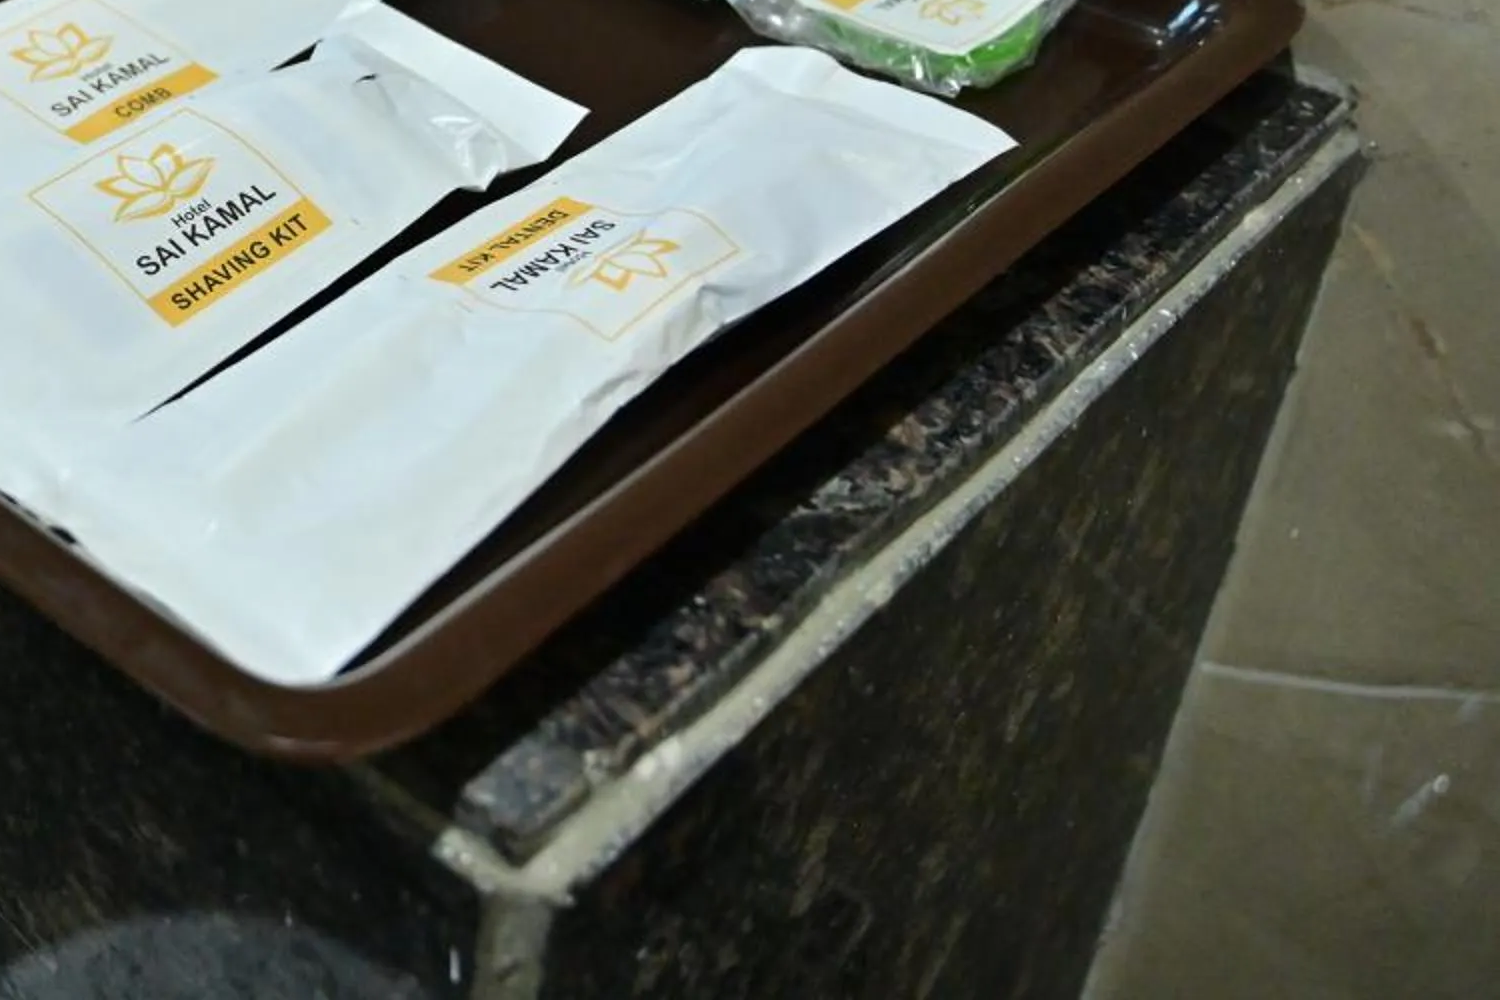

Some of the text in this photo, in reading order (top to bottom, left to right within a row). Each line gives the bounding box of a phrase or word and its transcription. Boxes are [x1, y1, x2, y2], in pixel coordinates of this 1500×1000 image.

[51, 89, 95, 117] SAI
[90, 53, 170, 93] KAMAL
[115, 87, 172, 118] COMB
[136, 185, 277, 276] SAI KAMAL
[171, 198, 211, 229] Hotel
[459, 209, 570, 272] DENTAL KIT
[569, 219, 616, 245] SAI
[171, 213, 308, 310] SHAVING KIT
[489, 243, 578, 291] KAMAL
